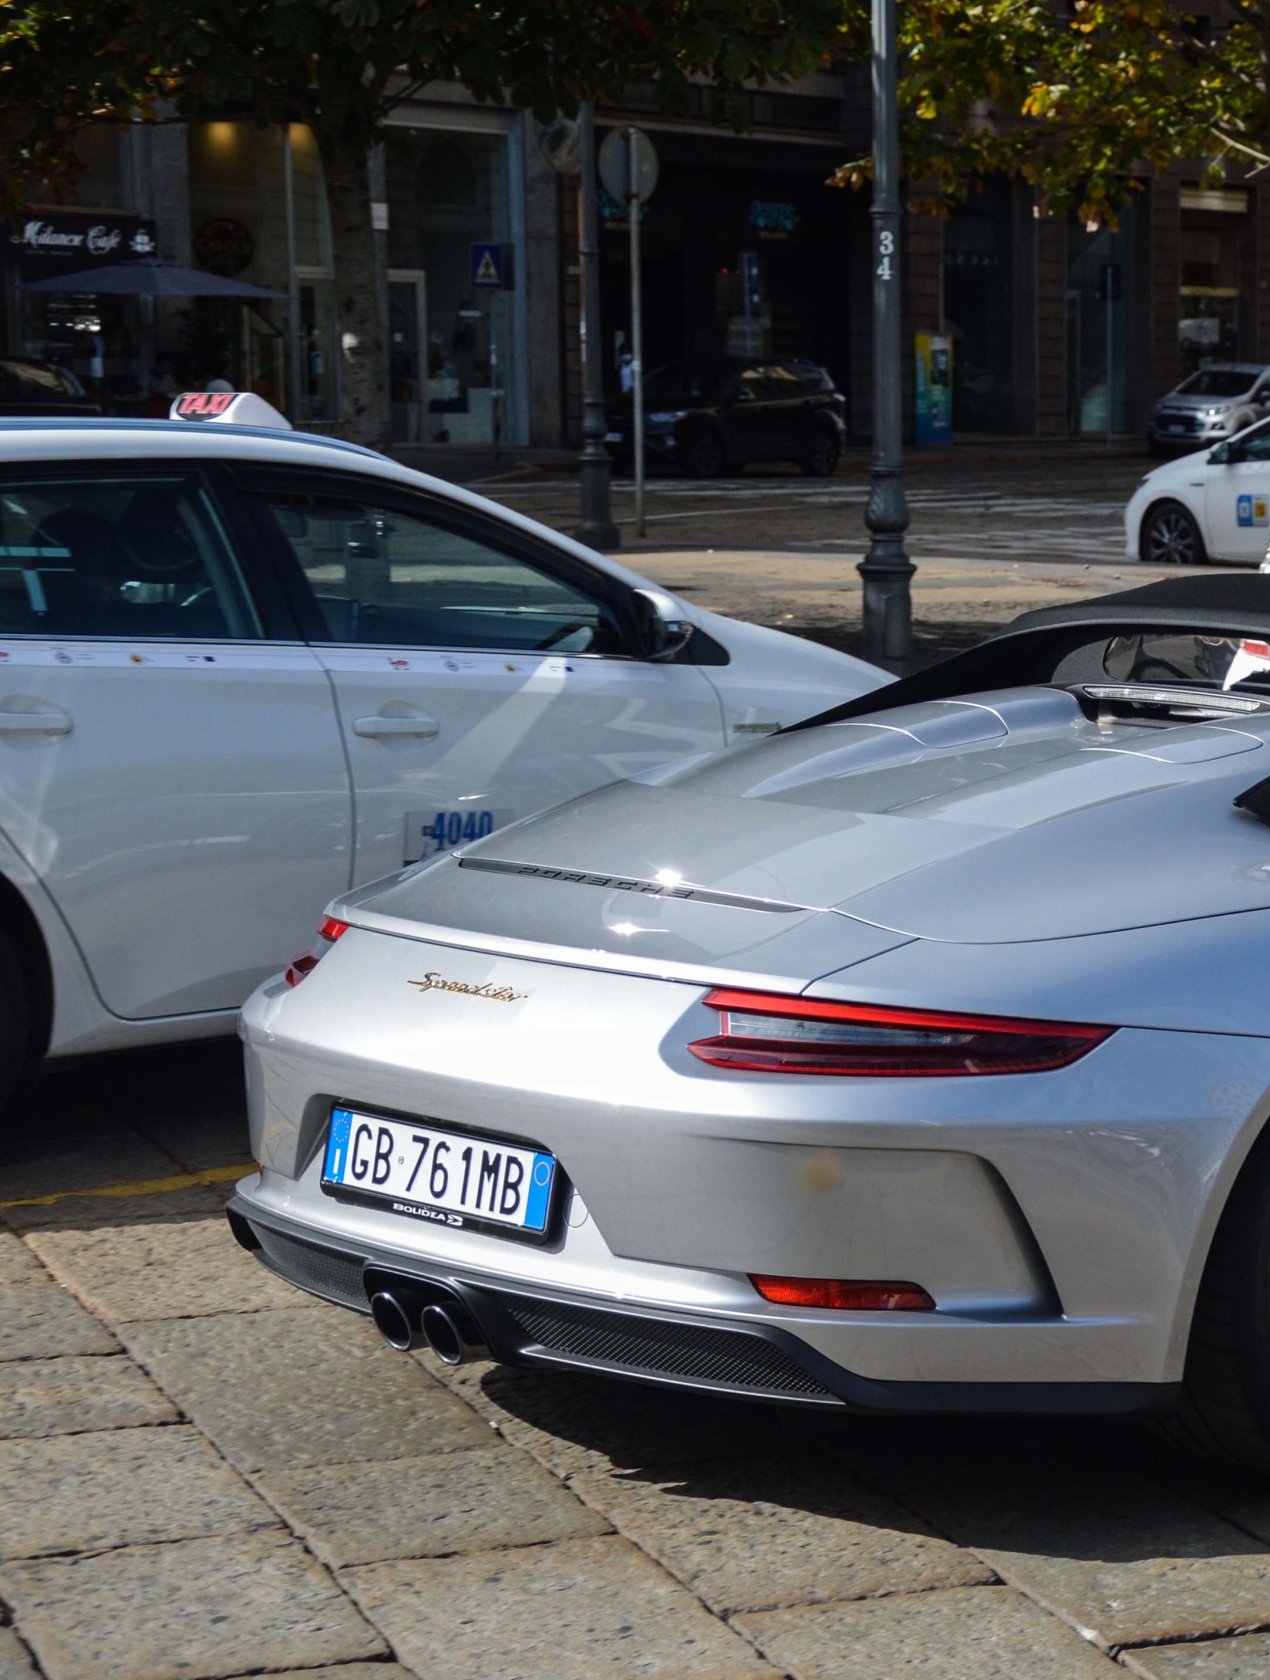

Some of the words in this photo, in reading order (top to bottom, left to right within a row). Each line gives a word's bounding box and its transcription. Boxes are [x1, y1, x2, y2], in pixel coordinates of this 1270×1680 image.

[178, 394, 235, 414] TAXI
[432, 812, 493, 851] 4040
[518, 866, 694, 899] PORSCHE
[407, 972, 528, 1003] Speedster
[351, 1123, 394, 1185] GB
[405, 1134, 525, 1216] 761MB
[393, 1203, 446, 1222] BOLIDEA
